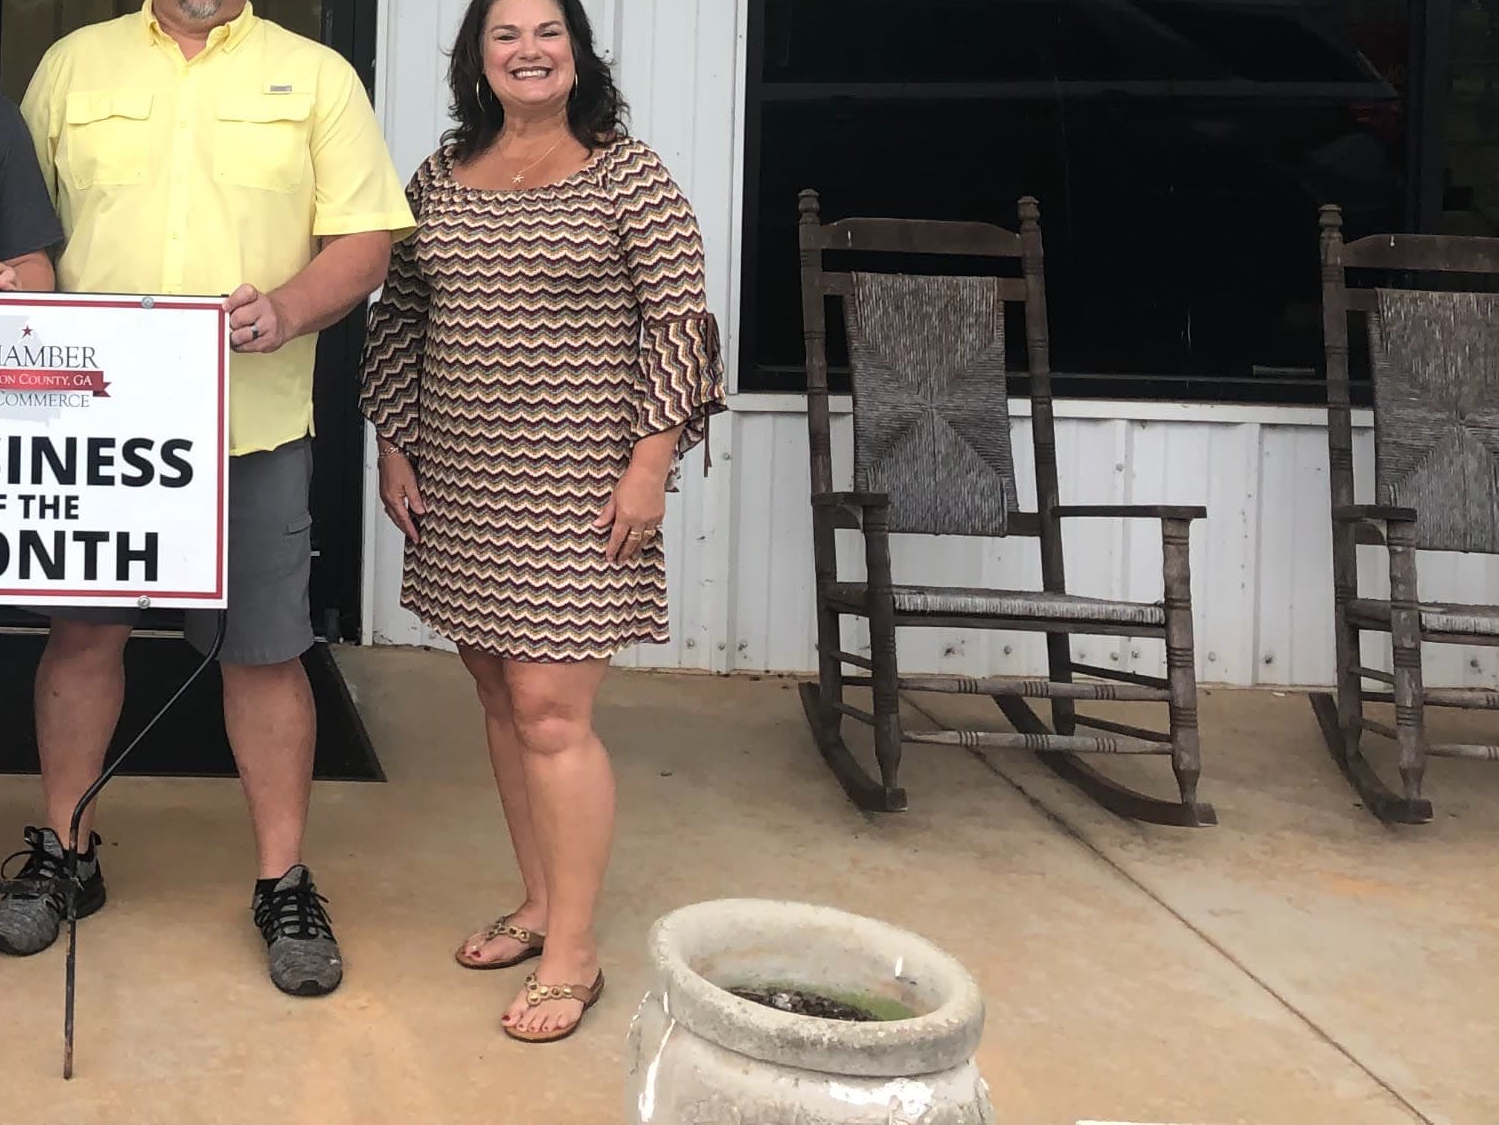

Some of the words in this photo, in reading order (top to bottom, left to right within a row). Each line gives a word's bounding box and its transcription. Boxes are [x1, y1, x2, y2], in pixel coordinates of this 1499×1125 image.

[18, 373, 71, 386] COUNTY,
[73, 375, 93, 387] GA
[18, 494, 80, 520] THE
